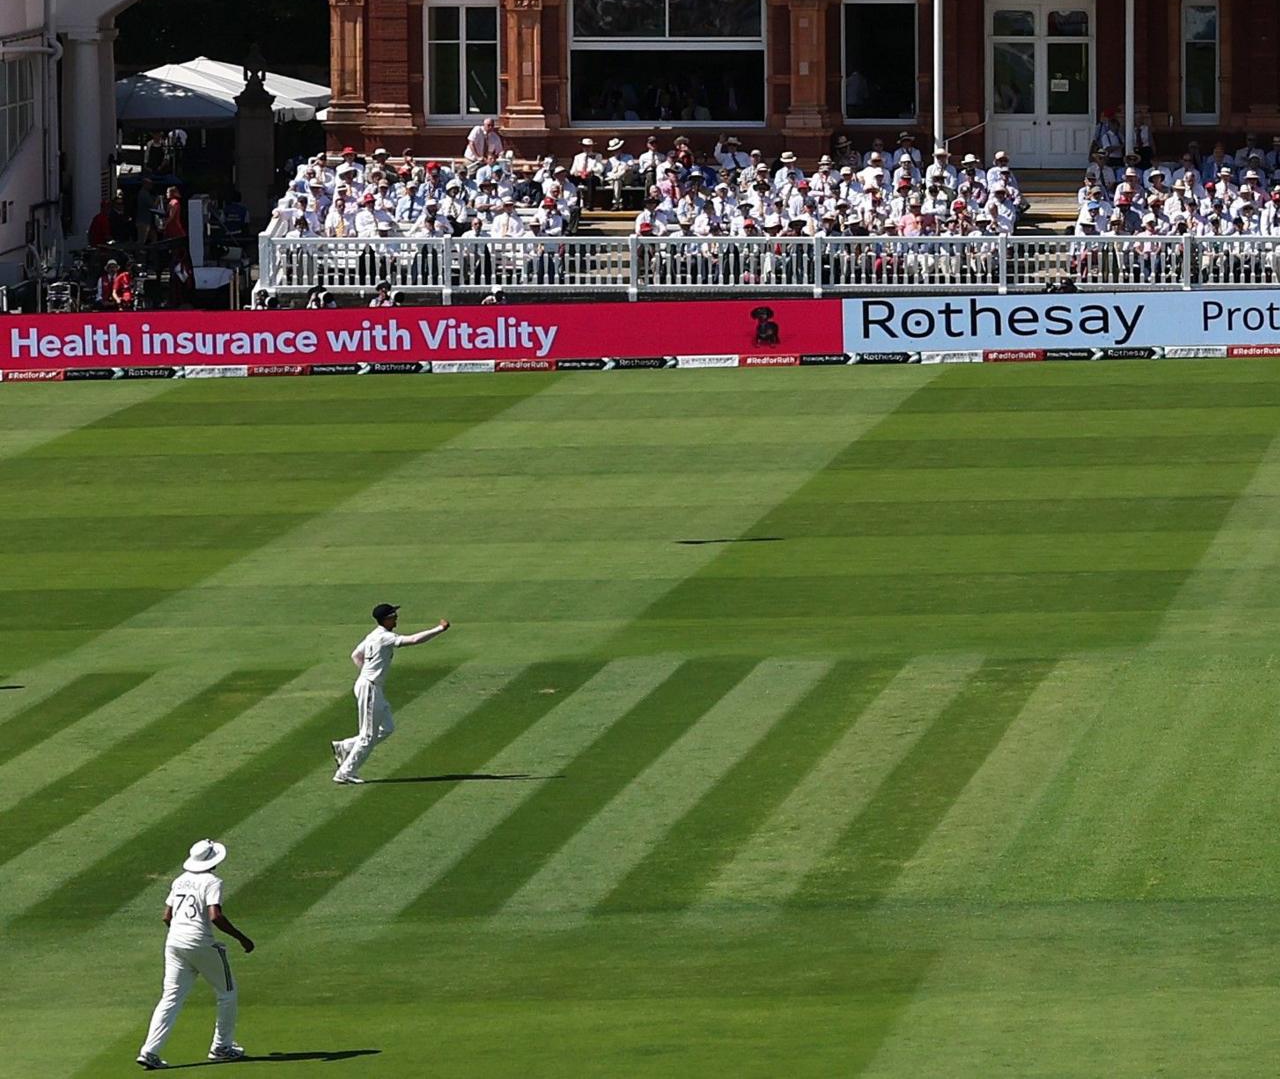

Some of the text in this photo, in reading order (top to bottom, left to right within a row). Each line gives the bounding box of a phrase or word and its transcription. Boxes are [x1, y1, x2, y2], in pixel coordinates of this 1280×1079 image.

[11, 317, 558, 358] Health insurance with Vitality
[863, 298, 1145, 344] Rothesay
[747, 356, 795, 364] #RedforRuth
[174, 893, 197, 919] 73
